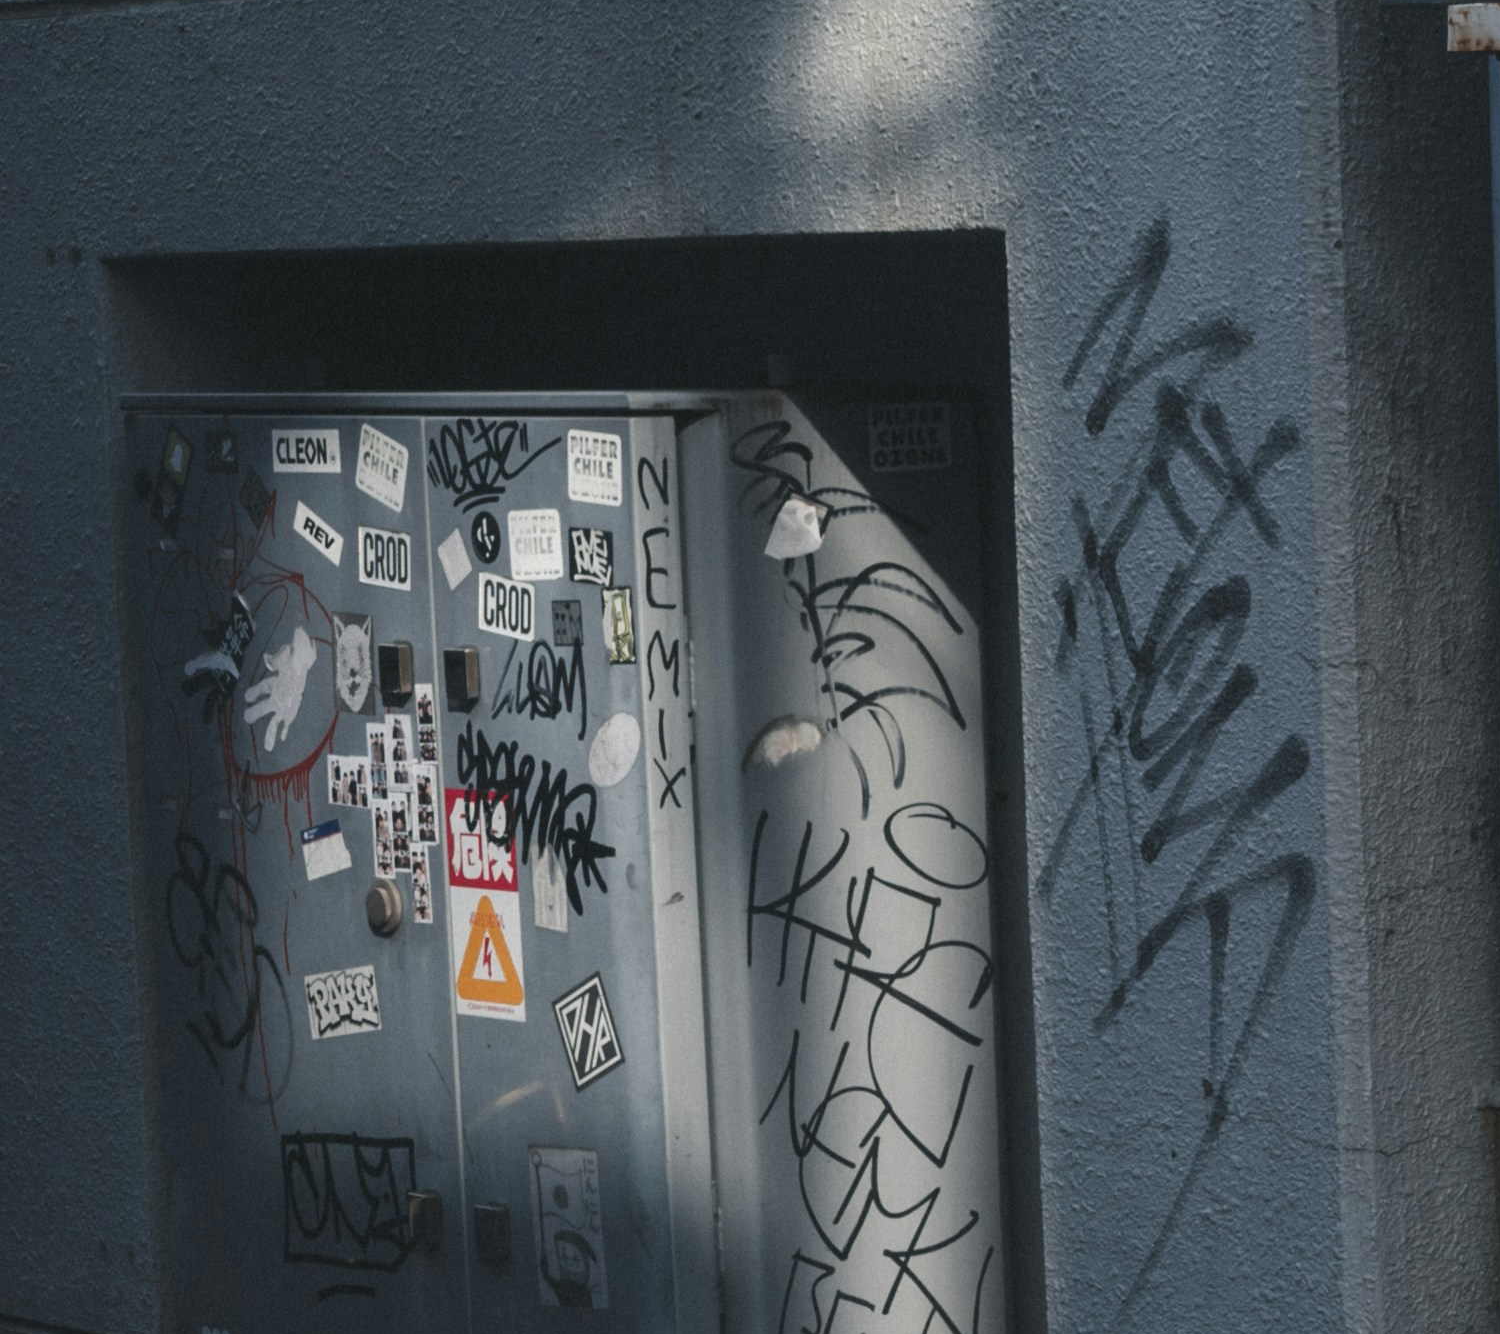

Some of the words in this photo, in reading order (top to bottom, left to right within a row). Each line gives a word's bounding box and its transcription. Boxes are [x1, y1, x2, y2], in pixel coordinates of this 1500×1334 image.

[276, 437, 328, 465] CLEON
[363, 451, 399, 486] CHILE
[573, 457, 614, 480] CHILE
[303, 516, 335, 551] REV
[363, 532, 409, 586] CROD
[484, 578, 533, 636] CROD
